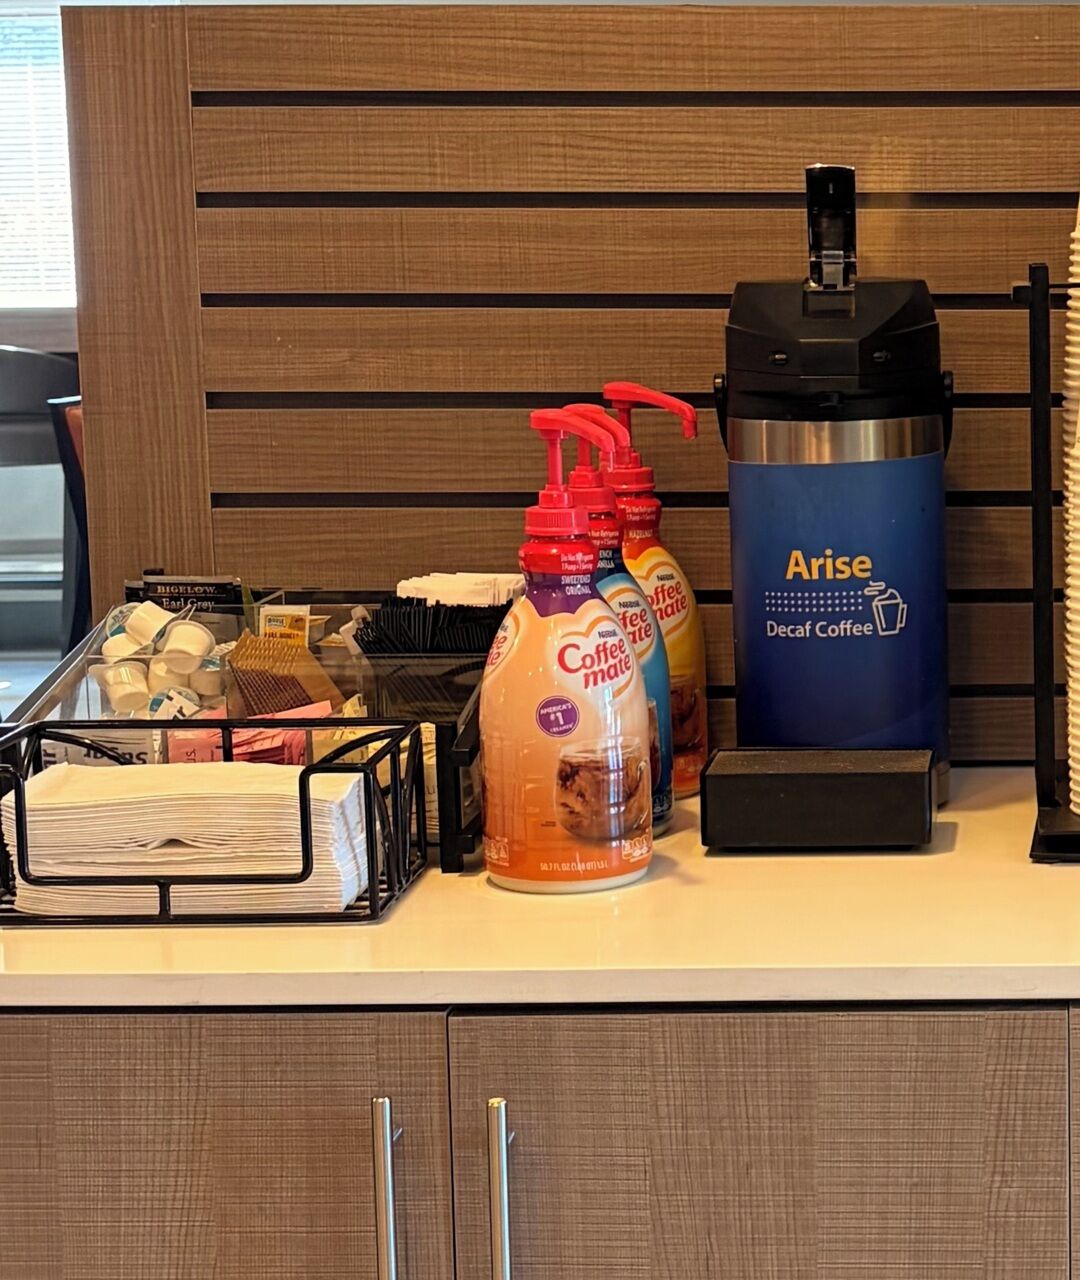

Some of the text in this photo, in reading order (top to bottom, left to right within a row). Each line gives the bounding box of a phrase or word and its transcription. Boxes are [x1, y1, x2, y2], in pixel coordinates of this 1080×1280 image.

[596, 560, 615, 568] ANILLA
[784, 548, 873, 581] Arise
[162, 598, 215, 612] Earl Grey
[646, 581, 683, 608] offee
[619, 608, 648, 629] fee
[766, 619, 874, 638] Decaf Coffee
[628, 622, 653, 645] ate
[557, 638, 627, 674] Coffee
[583, 654, 632, 690] mate
